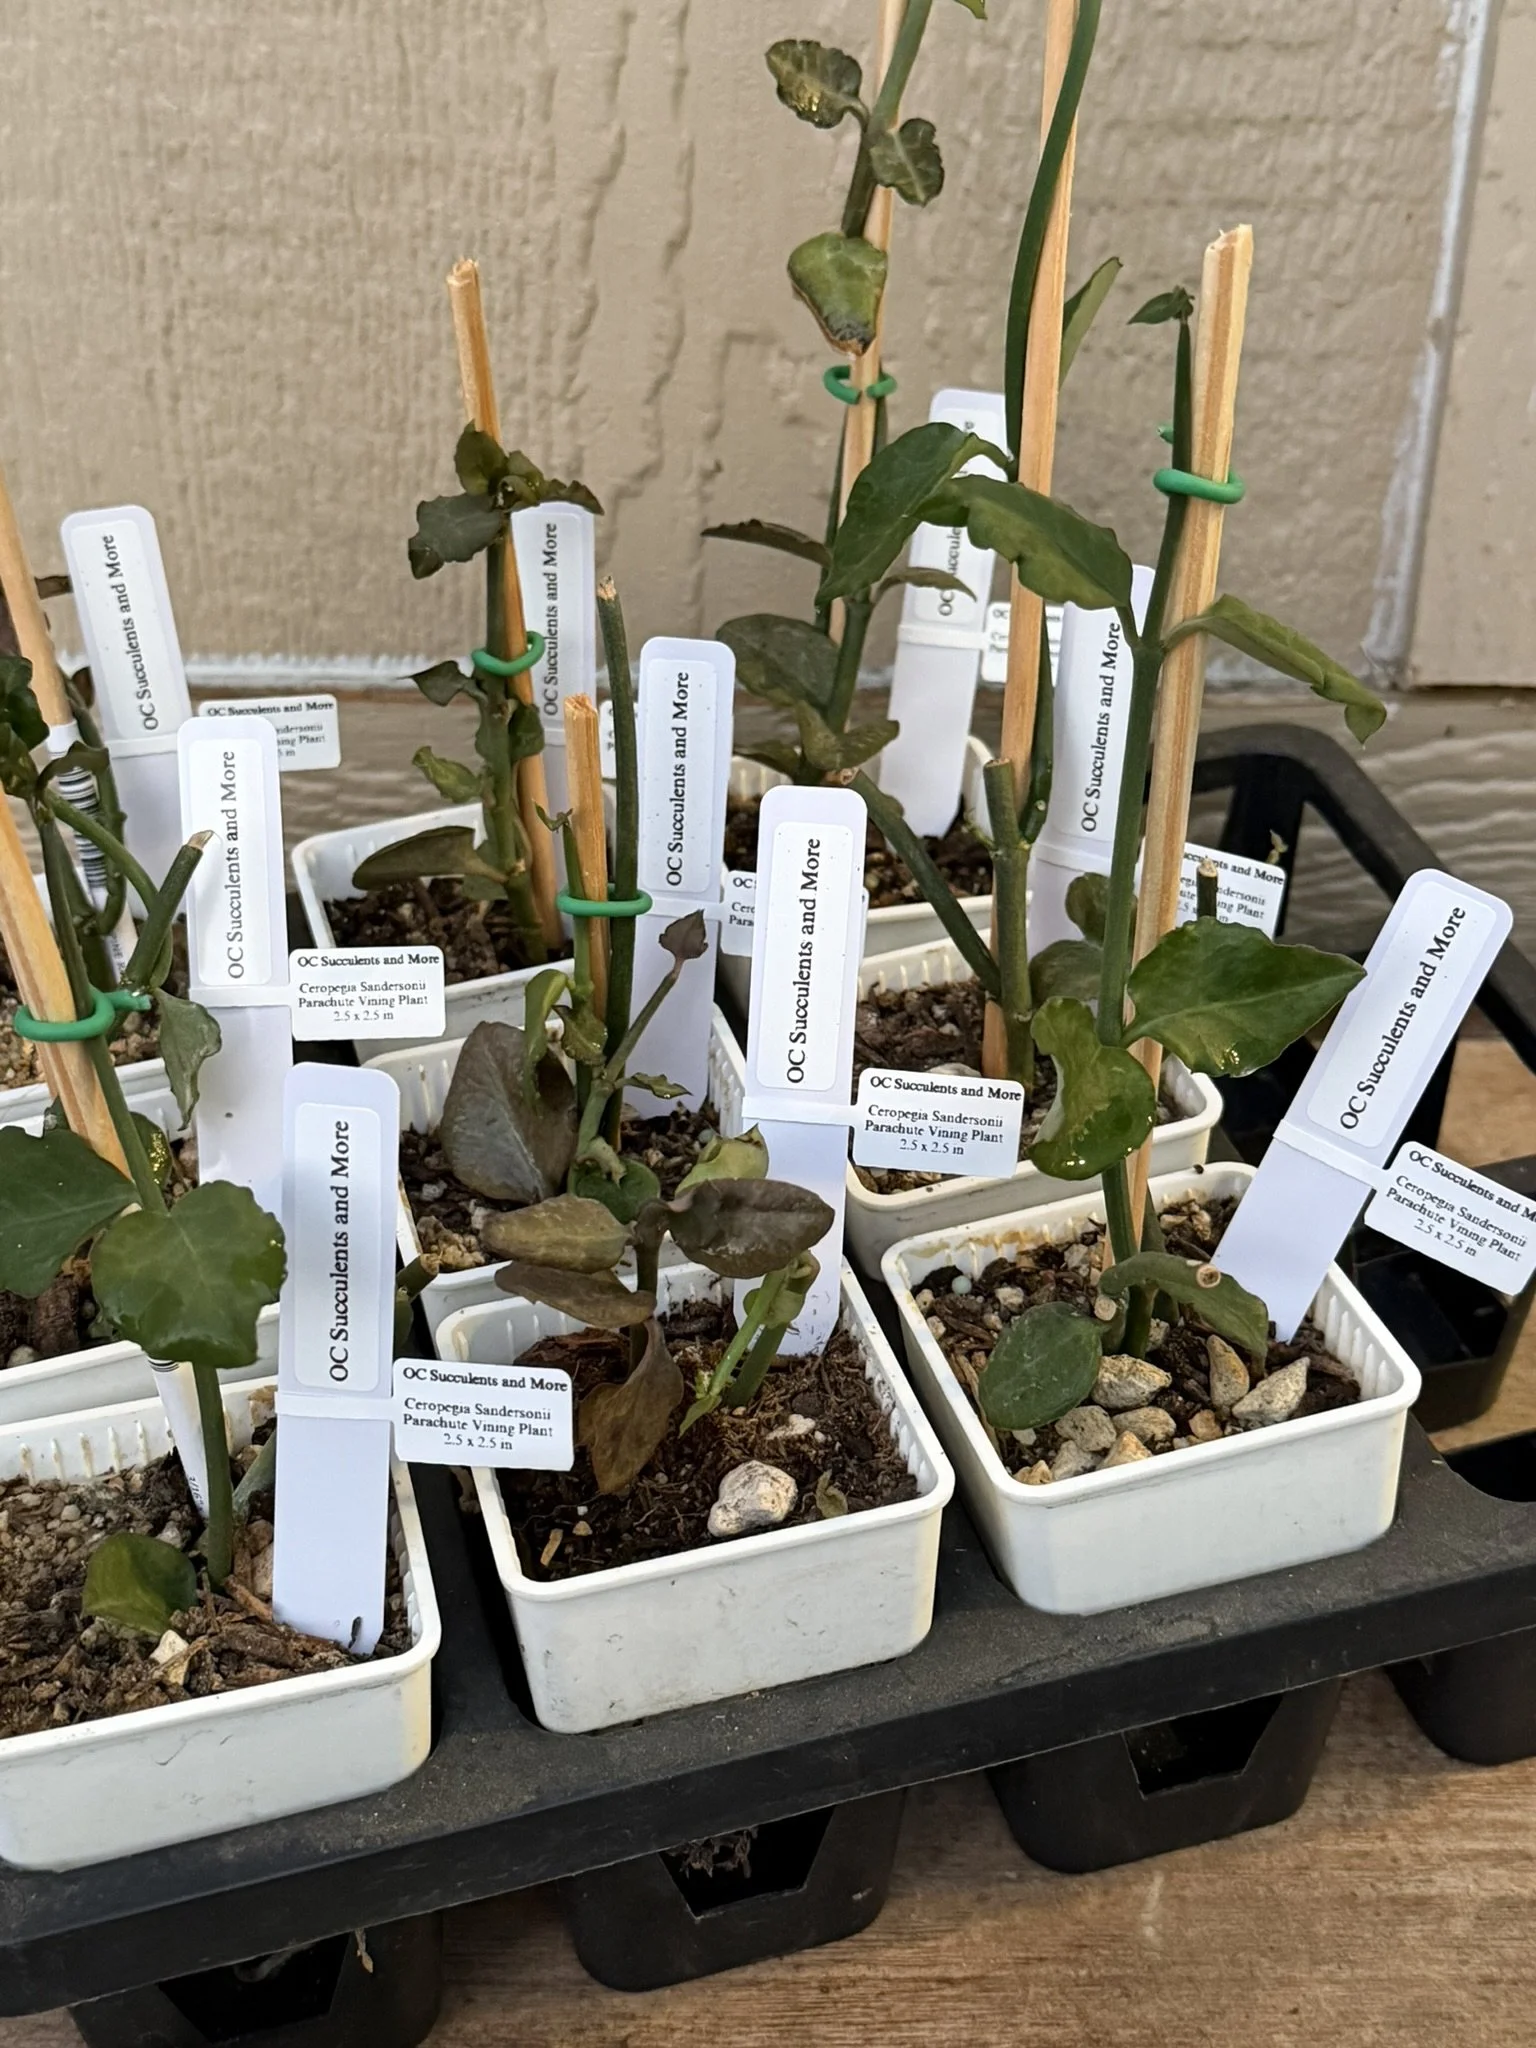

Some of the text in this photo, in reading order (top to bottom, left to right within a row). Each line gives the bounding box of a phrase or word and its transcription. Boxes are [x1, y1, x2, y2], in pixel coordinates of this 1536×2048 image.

[543, 523, 559, 717] OC Succulents and More
[102, 536, 158, 730] OC Succulents and More
[207, 702, 334, 716] OC Succulents and More
[1081, 621, 1121, 832] OC Succulents and More
[666, 673, 688, 887] OC Succulents and More
[221, 752, 244, 979] OC Succulents and More
[1230, 865, 1251, 876] and
[1254, 868, 1284, 885] More
[732, 877, 753, 889] OC
[1236, 903, 1265, 919] Plant
[298, 954, 439, 966] OC Succulents and More
[787, 839, 820, 1083] OC Succulents and More
[299, 981, 426, 996] Ceropegia Sandersonii
[299, 992, 428, 1008] Parachute Vining Plant
[1340, 906, 1466, 1129] OC Succulents and More
[870, 1076, 1021, 1101] OC Succulents and More
[868, 1105, 1003, 1127] Ceropegia Sandersonii
[865, 1120, 1004, 1143] Parachute Vining Plant
[1409, 1151, 1520, 1213] OC Succulents and
[1386, 1187, 1520, 1261] Parachute Vining Plant
[1396, 1176, 1526, 1247] Ceropegia Sandersonii
[329, 1121, 349, 1382] OC Succulents and More
[403, 1367, 567, 1392] OC Succulents and More
[404, 1398, 550, 1420] Ceropegia Sandersonii
[404, 1414, 553, 1437] Parachute Vining Plant
